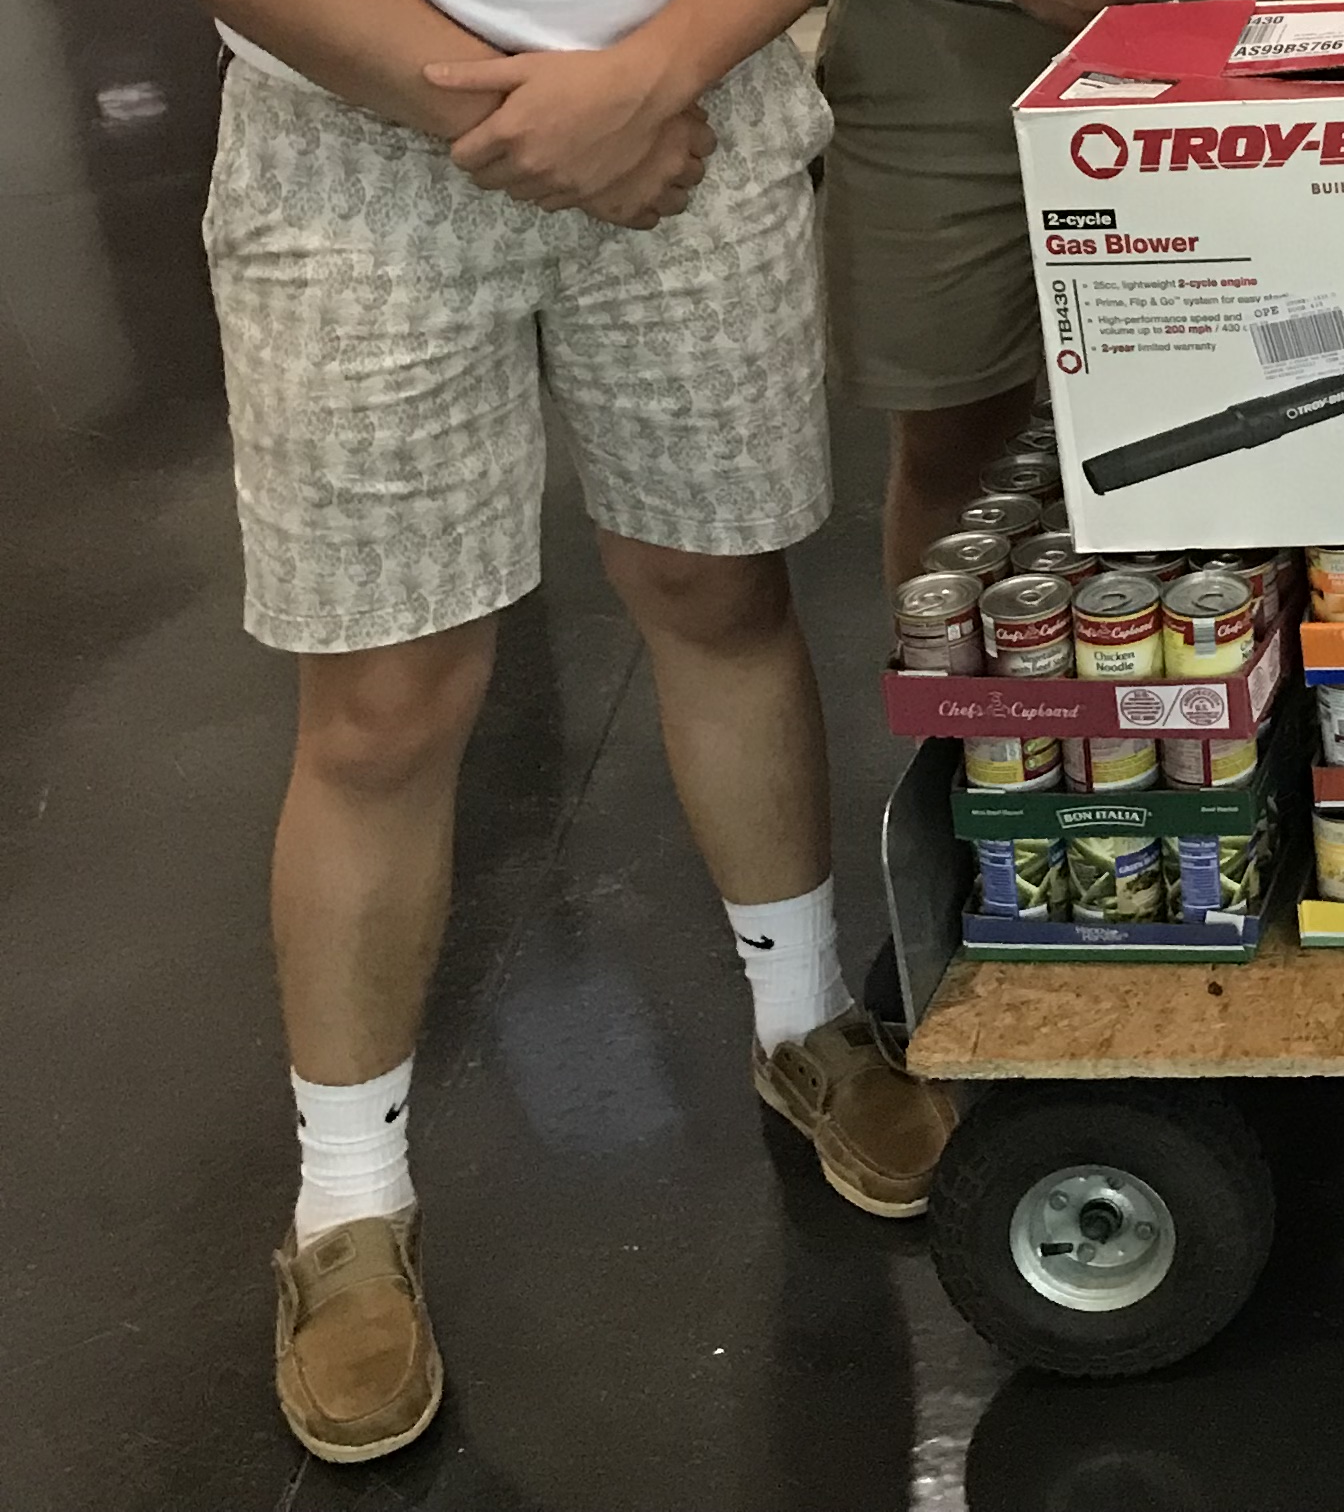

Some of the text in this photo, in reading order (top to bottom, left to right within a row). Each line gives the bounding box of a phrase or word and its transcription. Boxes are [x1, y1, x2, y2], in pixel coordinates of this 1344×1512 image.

[1248, 16, 1284, 25] 430
[1234, 40, 1344, 57] AS99BS766
[1048, 211, 1112, 229] 2-cycle
[1046, 233, 1199, 256] Gas Blower
[1178, 278, 1218, 288] 2-cycle
[1220, 277, 1258, 288] engine
[1220, 295, 1235, 304] for
[1052, 280, 1074, 345] TB430
[1223, 313, 1242, 322] and
[1254, 306, 1279, 318] OPE
[1137, 326, 1151, 337] up
[1153, 325, 1163, 334] to
[1164, 325, 1186, 334] 200
[1188, 324, 1212, 335] mph
[1096, 662, 1135, 672] Noodle
[1010, 700, 1081, 721] Cupboard
[1062, 809, 1140, 823] BON ITALIA
